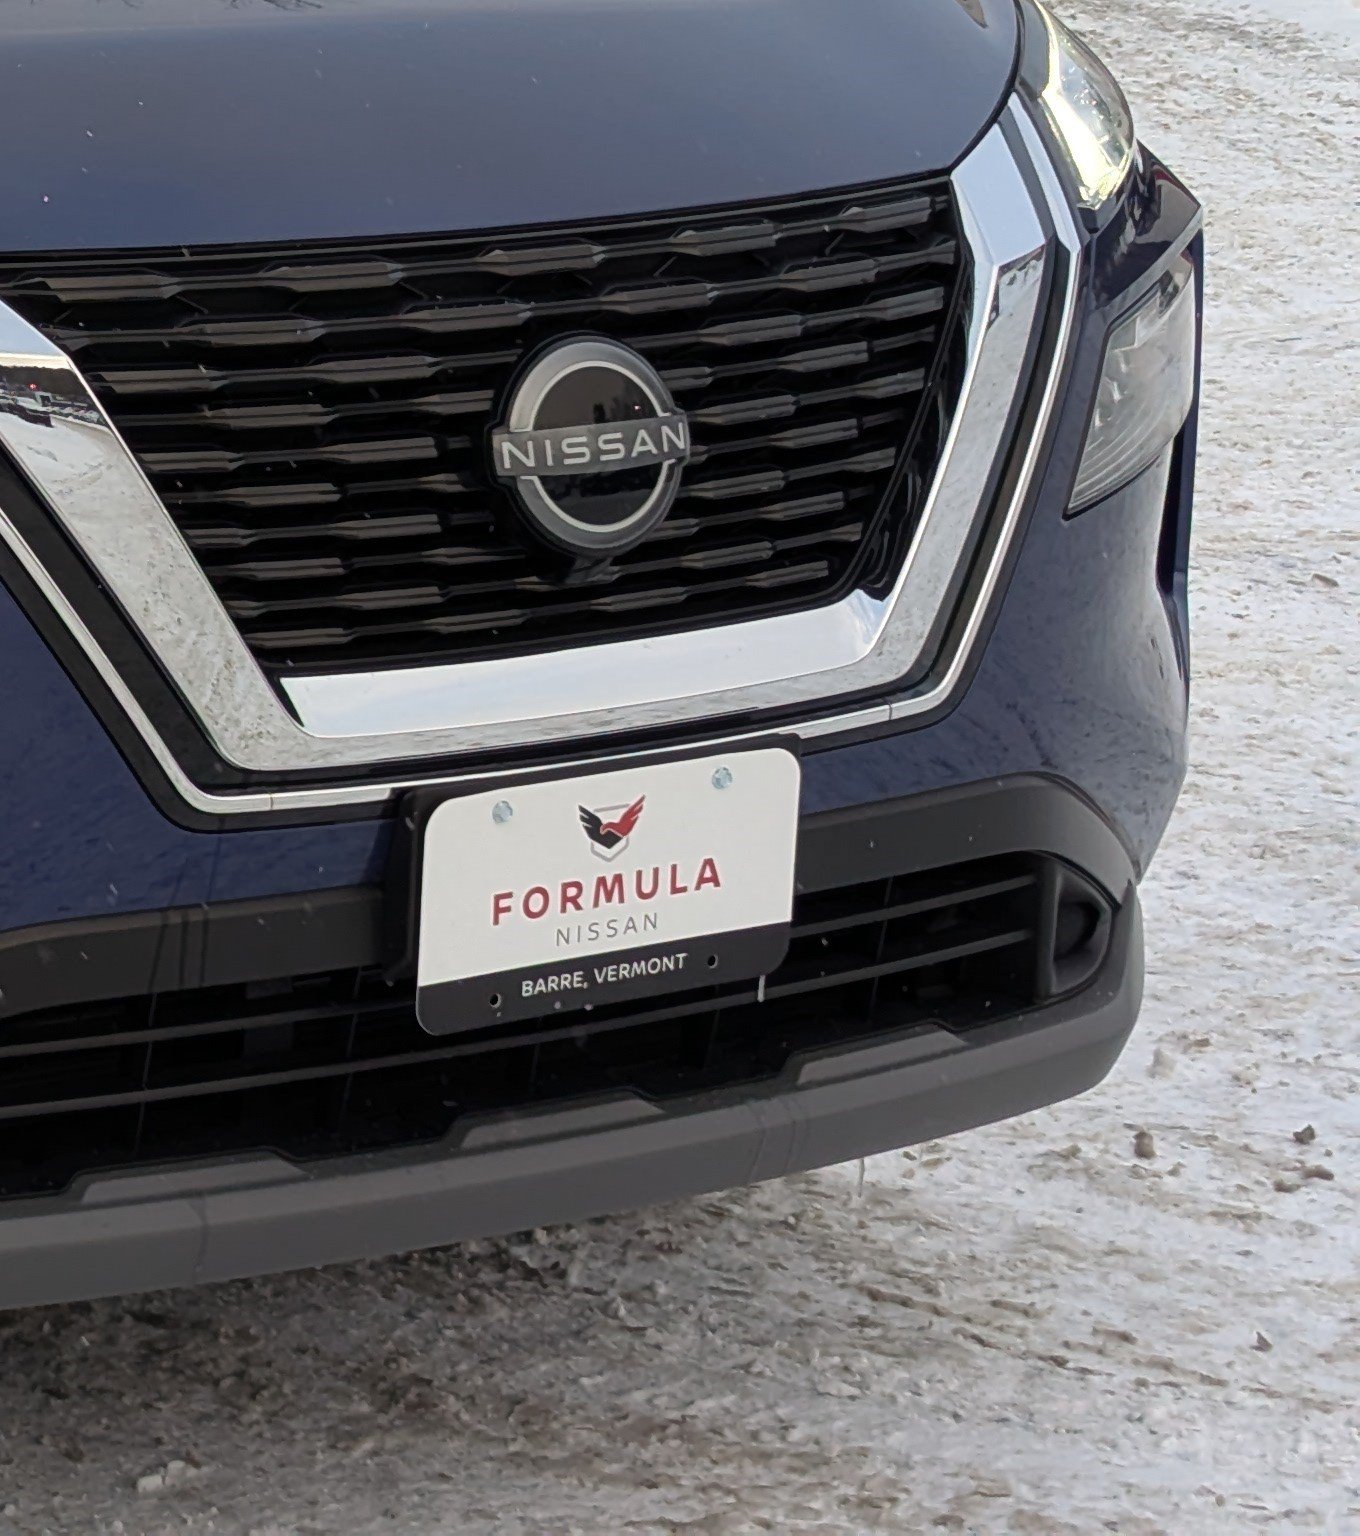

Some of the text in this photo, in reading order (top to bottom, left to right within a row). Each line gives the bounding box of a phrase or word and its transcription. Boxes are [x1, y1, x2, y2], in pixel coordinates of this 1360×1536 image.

[500, 422, 686, 469] NISSAN
[491, 856, 722, 926] FORMULA
[555, 912, 659, 947] NISSAN
[521, 952, 689, 998] BARRE, VERMONT
